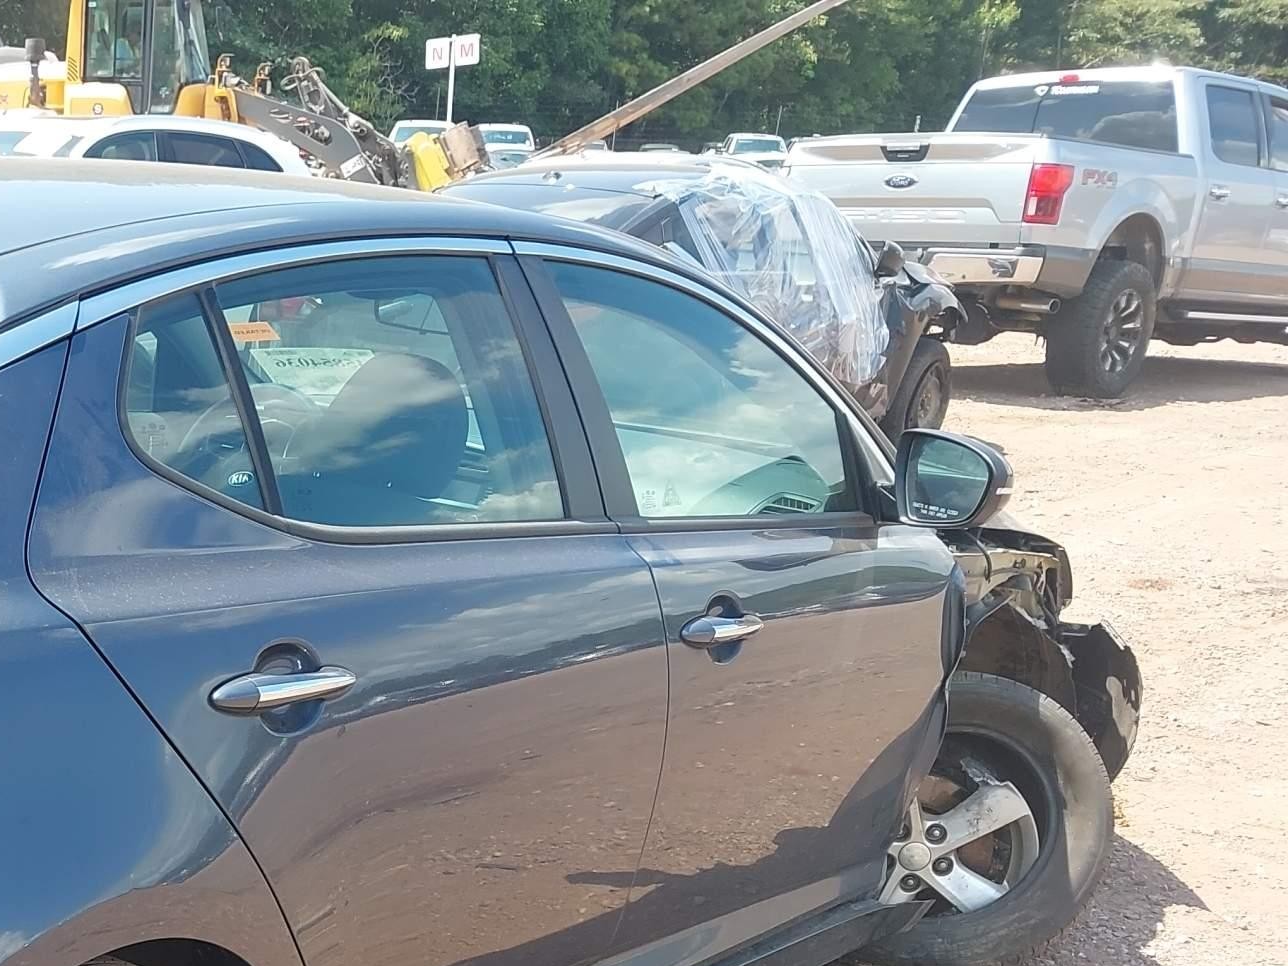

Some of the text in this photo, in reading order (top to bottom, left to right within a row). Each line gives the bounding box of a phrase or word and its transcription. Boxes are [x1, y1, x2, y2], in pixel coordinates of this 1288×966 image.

[432, 47, 443, 61] N
[460, 42, 474, 57] M
[1082, 169, 1118, 185] FX4
